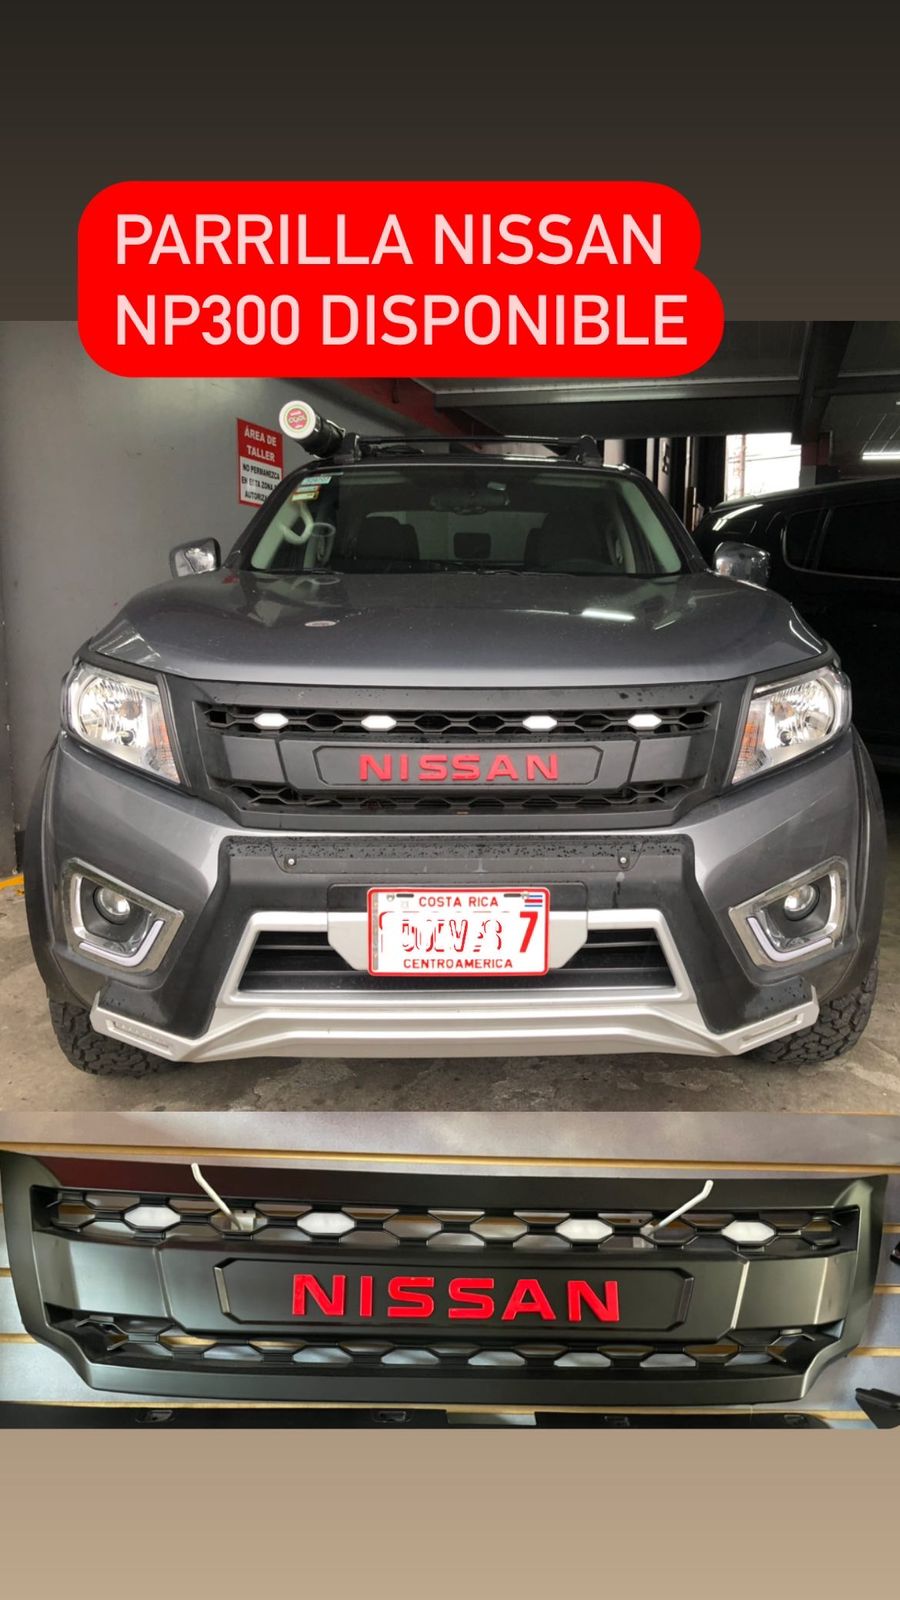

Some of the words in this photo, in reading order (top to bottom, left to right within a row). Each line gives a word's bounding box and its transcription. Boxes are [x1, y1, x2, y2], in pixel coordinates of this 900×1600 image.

[244, 425, 266, 444] ÁREA
[267, 434, 278, 447] DE
[246, 444, 276, 462] TALLER
[242, 463, 251, 473] NO
[250, 465, 280, 480] PERMANEZCA
[358, 753, 559, 783] NISSAN
[418, 896, 462, 908] COSTA
[468, 896, 499, 908] RICA
[403, 958, 513, 970] CENTROAMERICA
[291, 1273, 620, 1323] NISSAN
